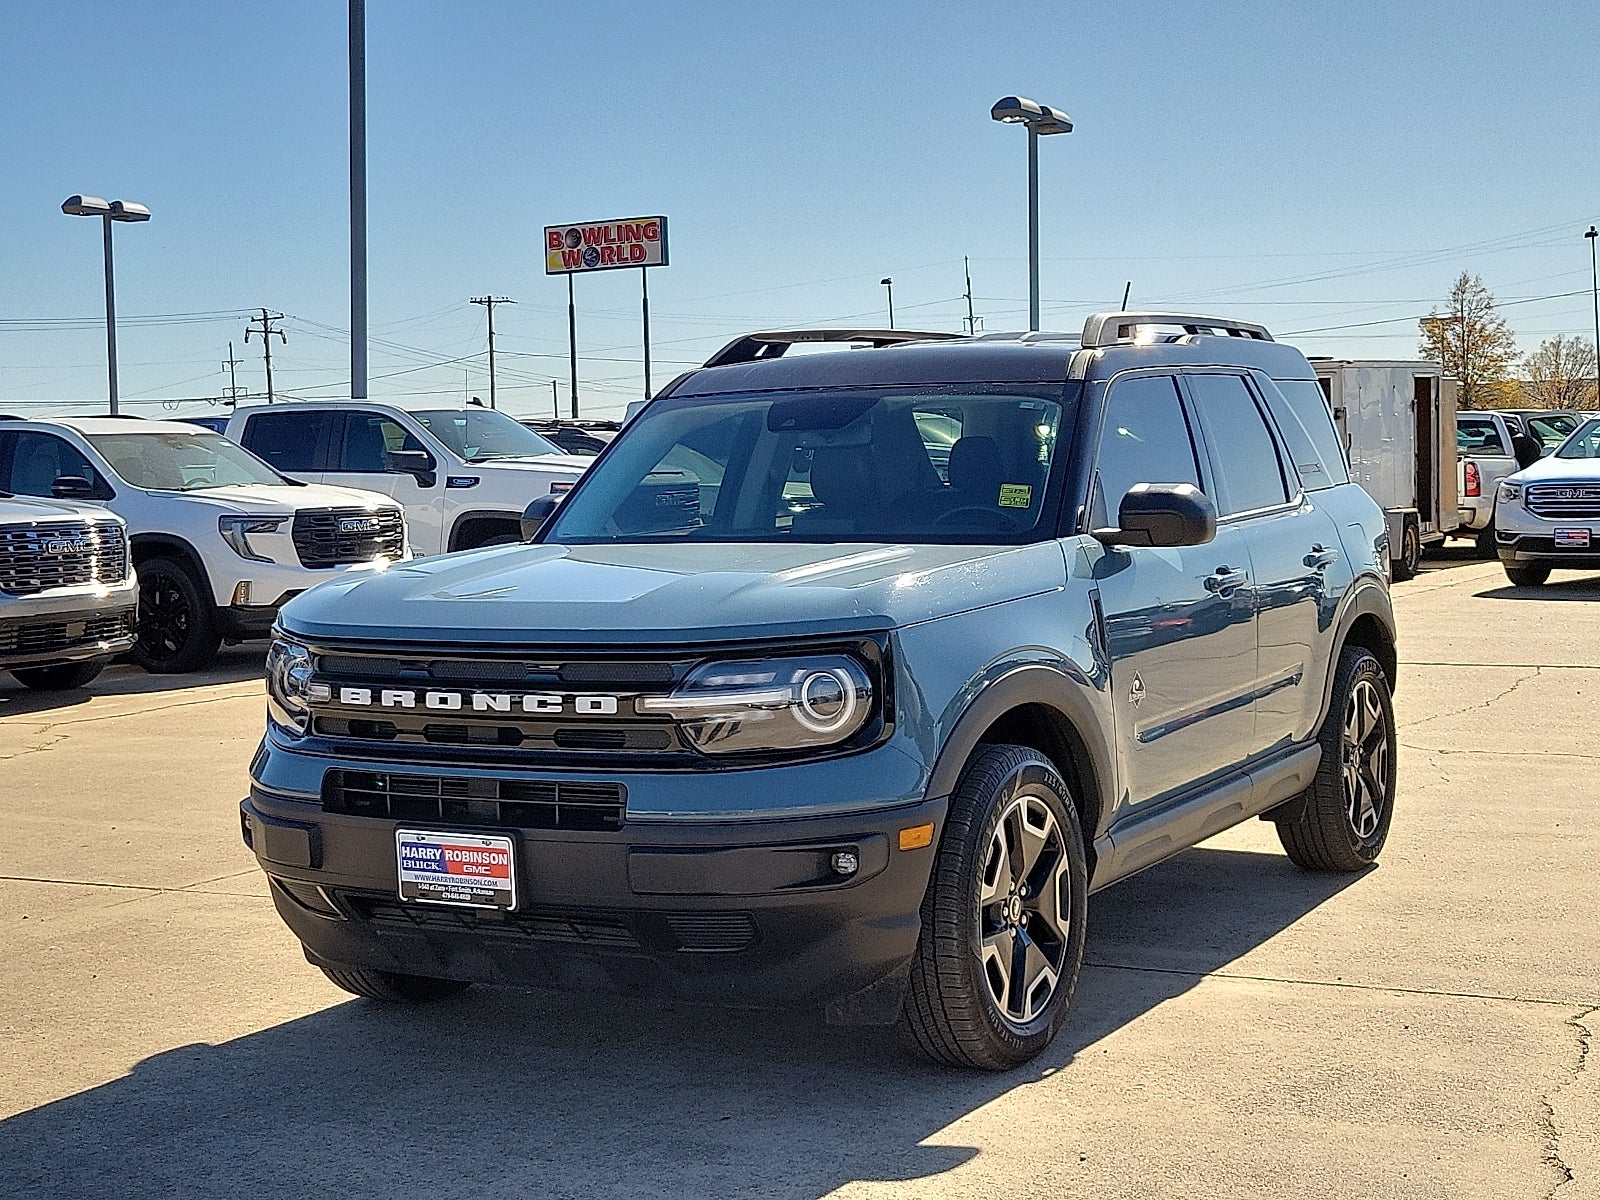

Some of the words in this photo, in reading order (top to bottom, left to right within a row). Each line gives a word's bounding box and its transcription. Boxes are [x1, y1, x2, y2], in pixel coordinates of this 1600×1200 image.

[548, 222, 659, 251] BOWLING
[561, 244, 647, 269] WORLD
[342, 520, 380, 532] GMC
[48, 540, 94, 554] GMC
[340, 687, 618, 714] BRONCO
[402, 845, 442, 860] HARRY
[444, 849, 508, 865] ROBINSON
[403, 859, 439, 870] BUICK
[463, 864, 491, 874] GMC
